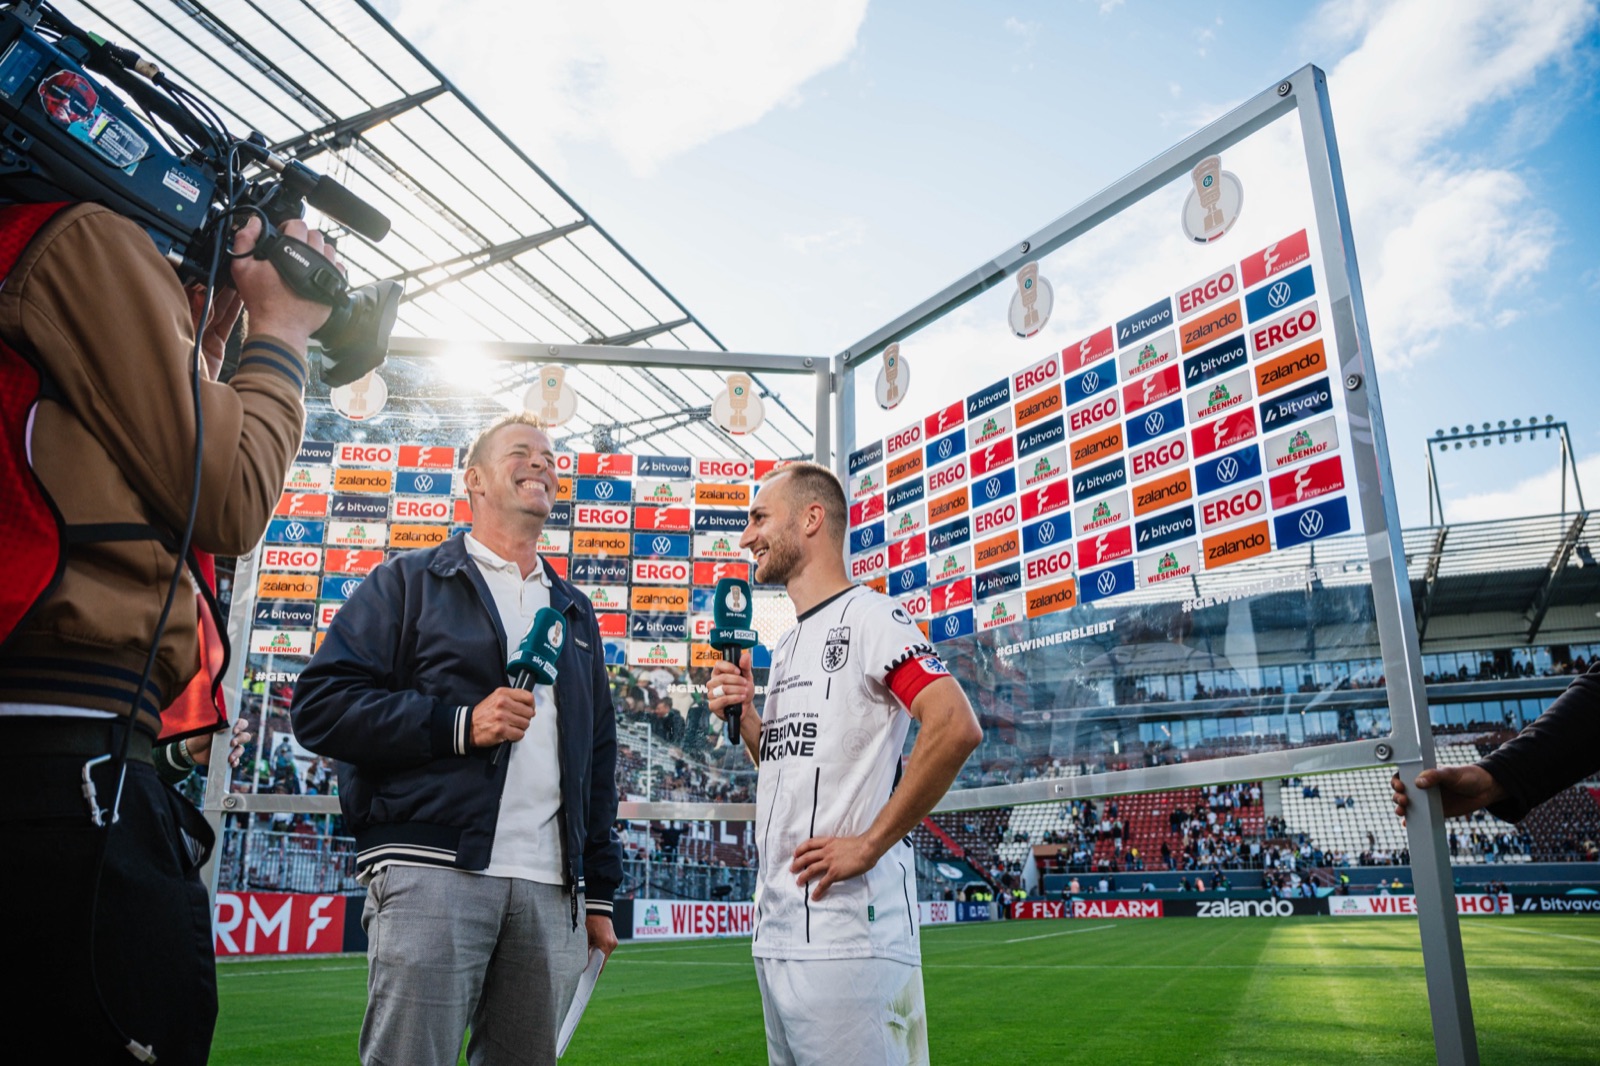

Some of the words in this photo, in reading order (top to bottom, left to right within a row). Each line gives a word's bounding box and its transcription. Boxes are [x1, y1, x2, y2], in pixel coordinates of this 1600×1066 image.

[284, 245, 310, 268] Canon
[1272, 252, 1308, 273] FLYERALARM
[1179, 272, 1235, 313] ERGO
[1131, 309, 1170, 333] bitvavo
[1185, 311, 1237, 345] zalando
[1254, 310, 1317, 352] ERGO
[1128, 352, 1169, 376] WIESENHOF
[1200, 347, 1244, 373] bitvavo
[1261, 352, 1320, 386] zalando
[1015, 360, 1057, 393] ERGO
[978, 389, 1008, 408] bitvavo
[1018, 394, 1059, 420] zalando
[1197, 394, 1243, 418] WIESENHOF
[1278, 390, 1328, 417] bitvavo
[1070, 398, 1117, 431] ERGO
[887, 426, 920, 454] ERGO
[975, 426, 1006, 445] WIESENHOF
[1029, 426, 1062, 446] bitvavo
[299, 447, 332, 458] itvavo
[341, 447, 392, 462] ERGO
[857, 448, 882, 464] bitvavo
[1074, 434, 1119, 460] zalando
[1276, 442, 1328, 466] WIESENHOF
[652, 461, 690, 473] bitvavo
[1132, 440, 1185, 475] ERGO
[699, 461, 748, 477] ERGO
[888, 457, 921, 478] zalando
[929, 462, 965, 492] ERGO
[1025, 467, 1060, 486] WIESENHOF
[339, 475, 387, 487] zalando
[1086, 469, 1124, 490] bitvavo
[699, 490, 746, 501] zalando
[896, 485, 923, 501] bitvavo
[1137, 480, 1187, 507] zalando
[1303, 483, 1342, 498] FLYERALARM
[347, 501, 386, 513] bitvavo
[396, 502, 447, 517] ERGO
[930, 497, 966, 517] zalando
[1203, 489, 1262, 525] ERGO
[578, 509, 628, 525] ERGO
[709, 515, 747, 526] bitvavo
[975, 505, 1016, 533] ERGO
[1082, 513, 1121, 532] WIESENHOF
[394, 531, 443, 543] zalando
[893, 522, 920, 537] WIESENHOF
[939, 526, 968, 543] bitvavo
[1151, 517, 1193, 539] bitvavo
[336, 536, 377, 545] WIESENHOF
[577, 538, 625, 549] zalando
[1208, 533, 1265, 560] zalando
[265, 551, 318, 567] ERGO
[977, 540, 1016, 561] zalando
[588, 565, 626, 576] bitvavo
[636, 565, 686, 580] ERGO
[852, 553, 884, 577] ERGO
[935, 565, 966, 581] WIESENHOF
[1027, 552, 1071, 580] ERGO
[1147, 565, 1191, 584] WIESENHOF
[263, 581, 313, 593] zalando
[987, 573, 1019, 590] bitvavo
[636, 594, 684, 605] zalando
[902, 596, 926, 615] GO
[1029, 589, 1072, 610] zalando
[271, 608, 312, 621] bitvavo
[983, 615, 1016, 629] WIESENHOF
[646, 621, 686, 632] bitvavo
[720, 630, 733, 639] sky
[736, 631, 755, 640] sport
[996, 619, 1116, 658] #GEWINNERBLEIBT
[532, 655, 544, 667] sky
[1032, 900, 1159, 918] FLYRALARM
[1197, 898, 1294, 918] zalando
[1369, 895, 1510, 914] WIEHOF
[1540, 897, 1600, 911] bitvavo
[671, 904, 755, 935] WIESENH
[635, 926, 669, 935] WIESENHOF
